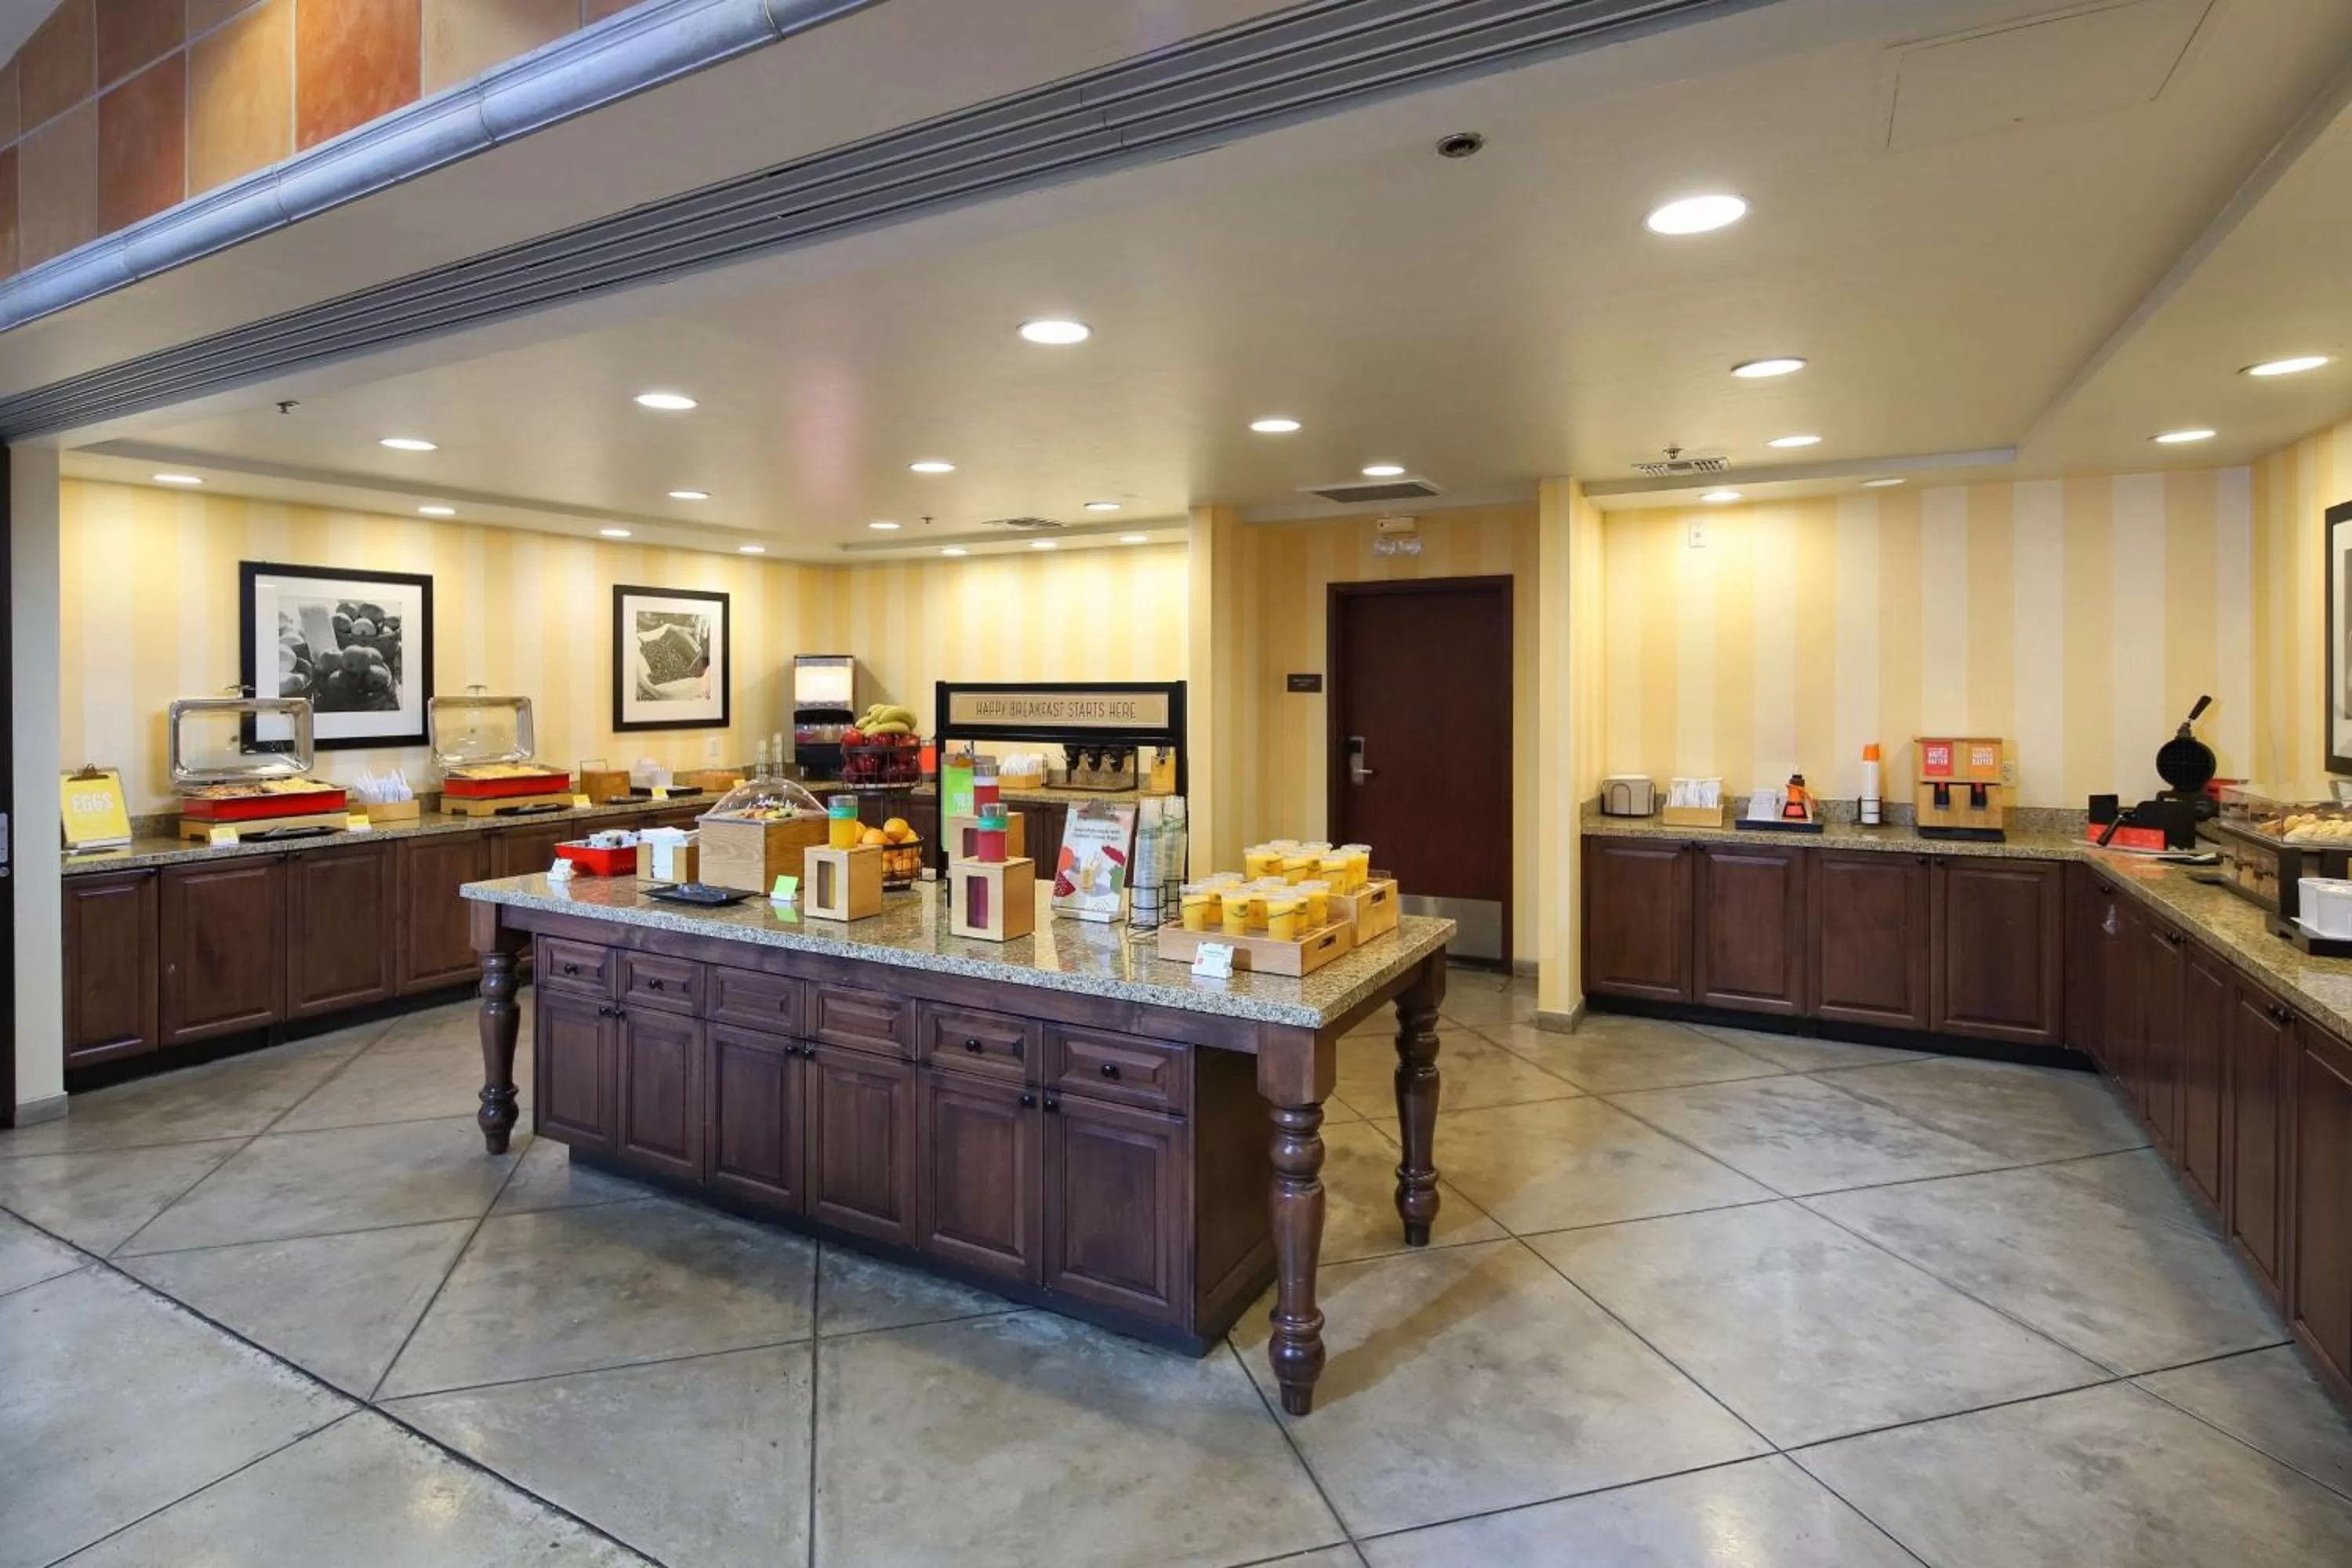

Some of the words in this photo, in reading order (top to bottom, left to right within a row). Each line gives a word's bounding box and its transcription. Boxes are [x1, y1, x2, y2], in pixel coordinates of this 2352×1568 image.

[975, 701, 1007, 716] HAPPY
[1009, 702, 1064, 717] BREAKFAST
[1068, 702, 1105, 719] STARTS
[1109, 702, 1137, 719] HERE
[72, 791, 114, 814] EGGS
